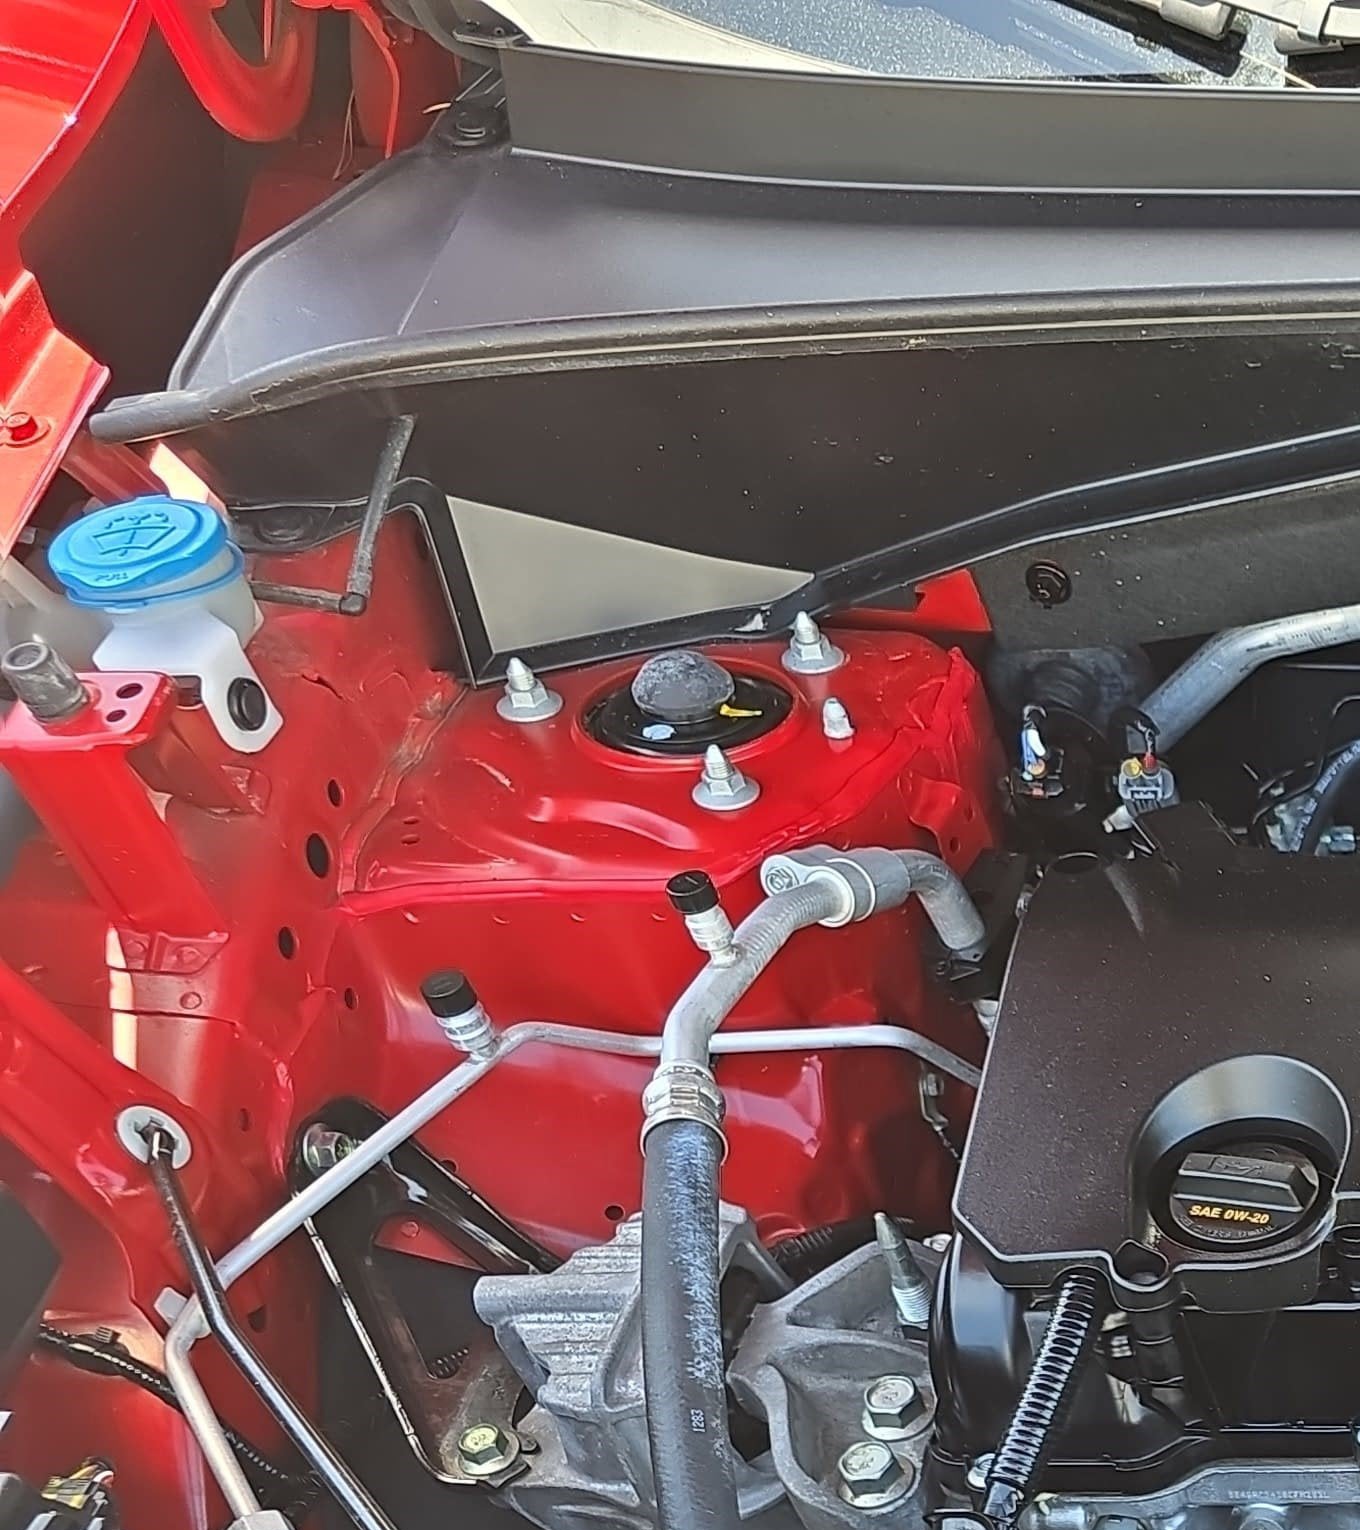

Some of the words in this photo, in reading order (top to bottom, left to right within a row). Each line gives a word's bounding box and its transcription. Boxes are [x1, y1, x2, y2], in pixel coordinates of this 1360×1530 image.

[1189, 1204, 1222, 1218] SAE
[1223, 1208, 1270, 1224] 0W-20
[690, 1409, 706, 1432] 1283
